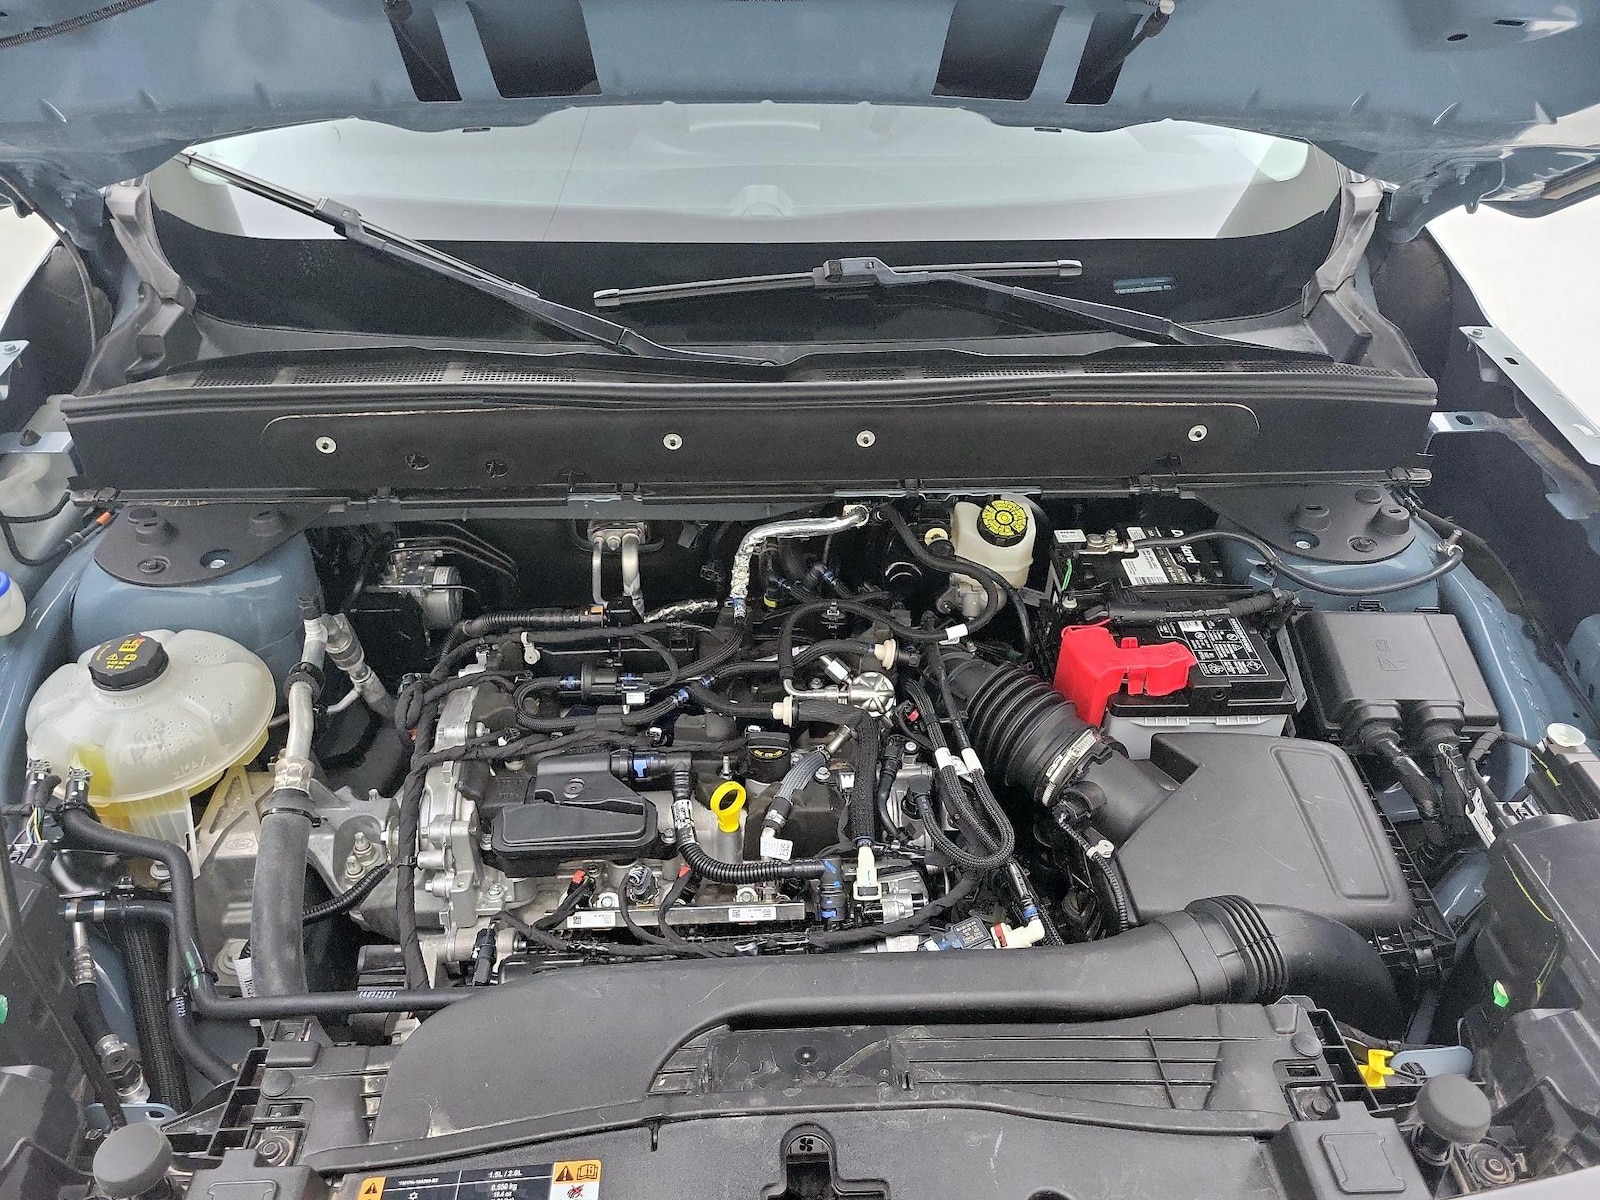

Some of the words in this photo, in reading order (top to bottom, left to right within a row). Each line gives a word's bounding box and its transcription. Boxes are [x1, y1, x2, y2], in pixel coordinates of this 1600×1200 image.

[507, 1169, 523, 1177] 2.0L
[491, 1183, 508, 1191] 0.550
[509, 1182, 518, 1191] kg
